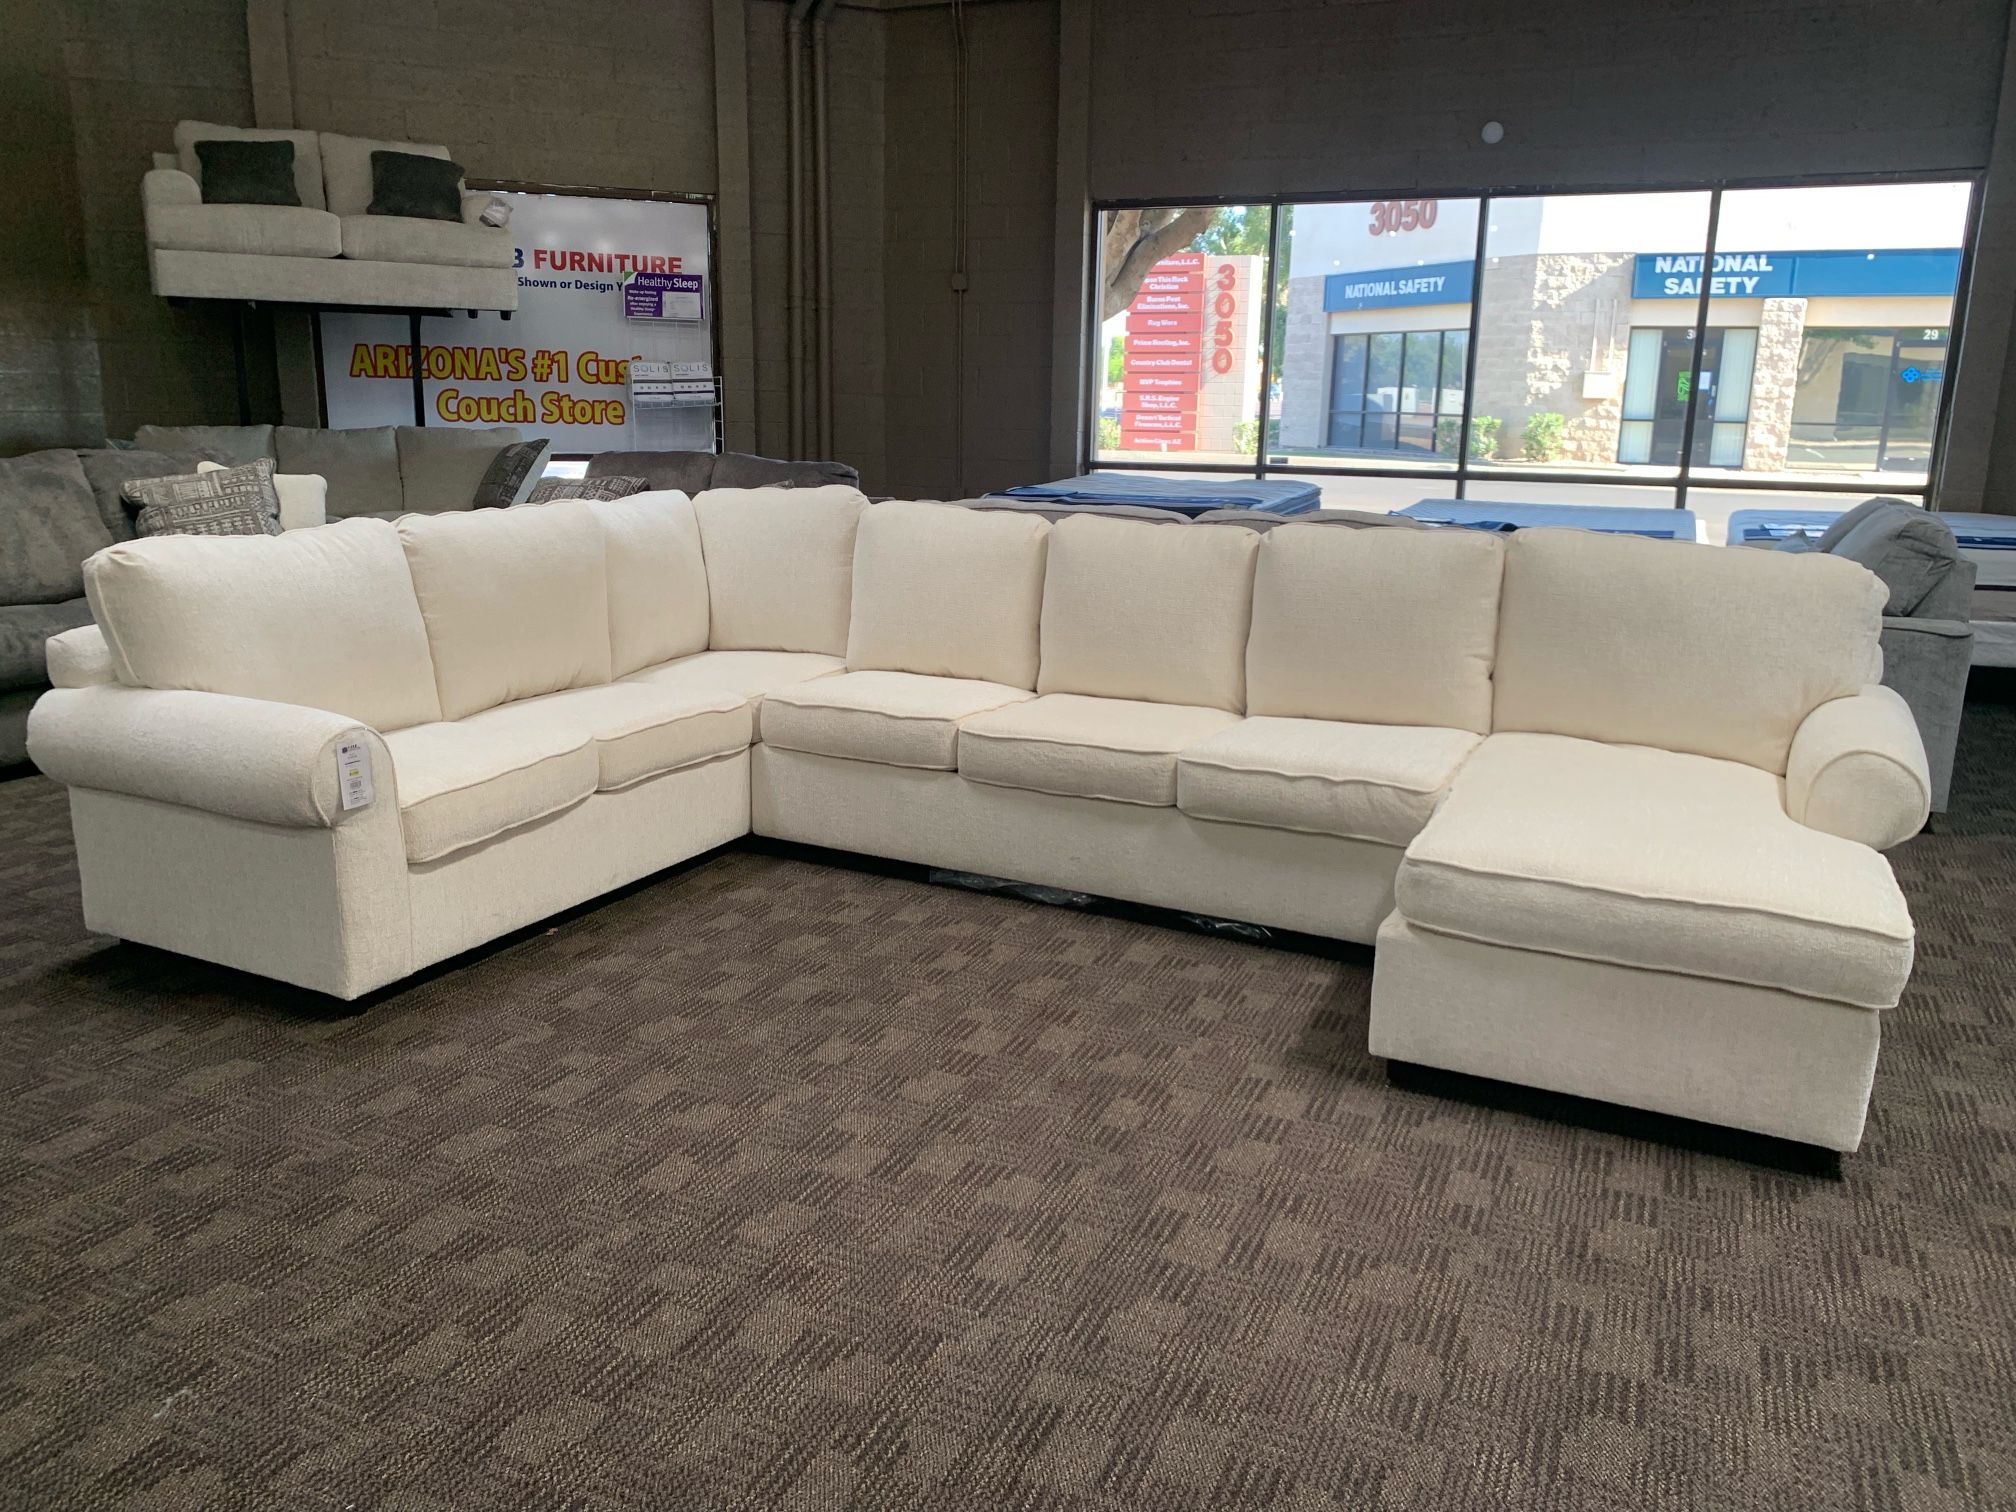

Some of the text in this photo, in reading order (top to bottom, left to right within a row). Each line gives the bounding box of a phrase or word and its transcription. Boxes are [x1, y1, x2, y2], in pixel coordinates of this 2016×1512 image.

[1369, 199, 1438, 236] 3050
[533, 249, 683, 274] FURNITURE
[1655, 254, 1773, 273] NATIONAL
[518, 277, 557, 289] Shown
[560, 281, 572, 289] or
[575, 279, 614, 293] Design
[638, 276, 699, 291] Healthy Sleep
[1345, 276, 1446, 299] NATIONAL SAFETY
[1686, 329, 1696, 340] 3
[1923, 328, 1939, 340] 29
[350, 344, 642, 385] ARIZONA'S #1 Cus
[633, 364, 669, 373] SOLIS
[674, 364, 708, 372] SOLIS
[436, 388, 625, 425] Couch Store
